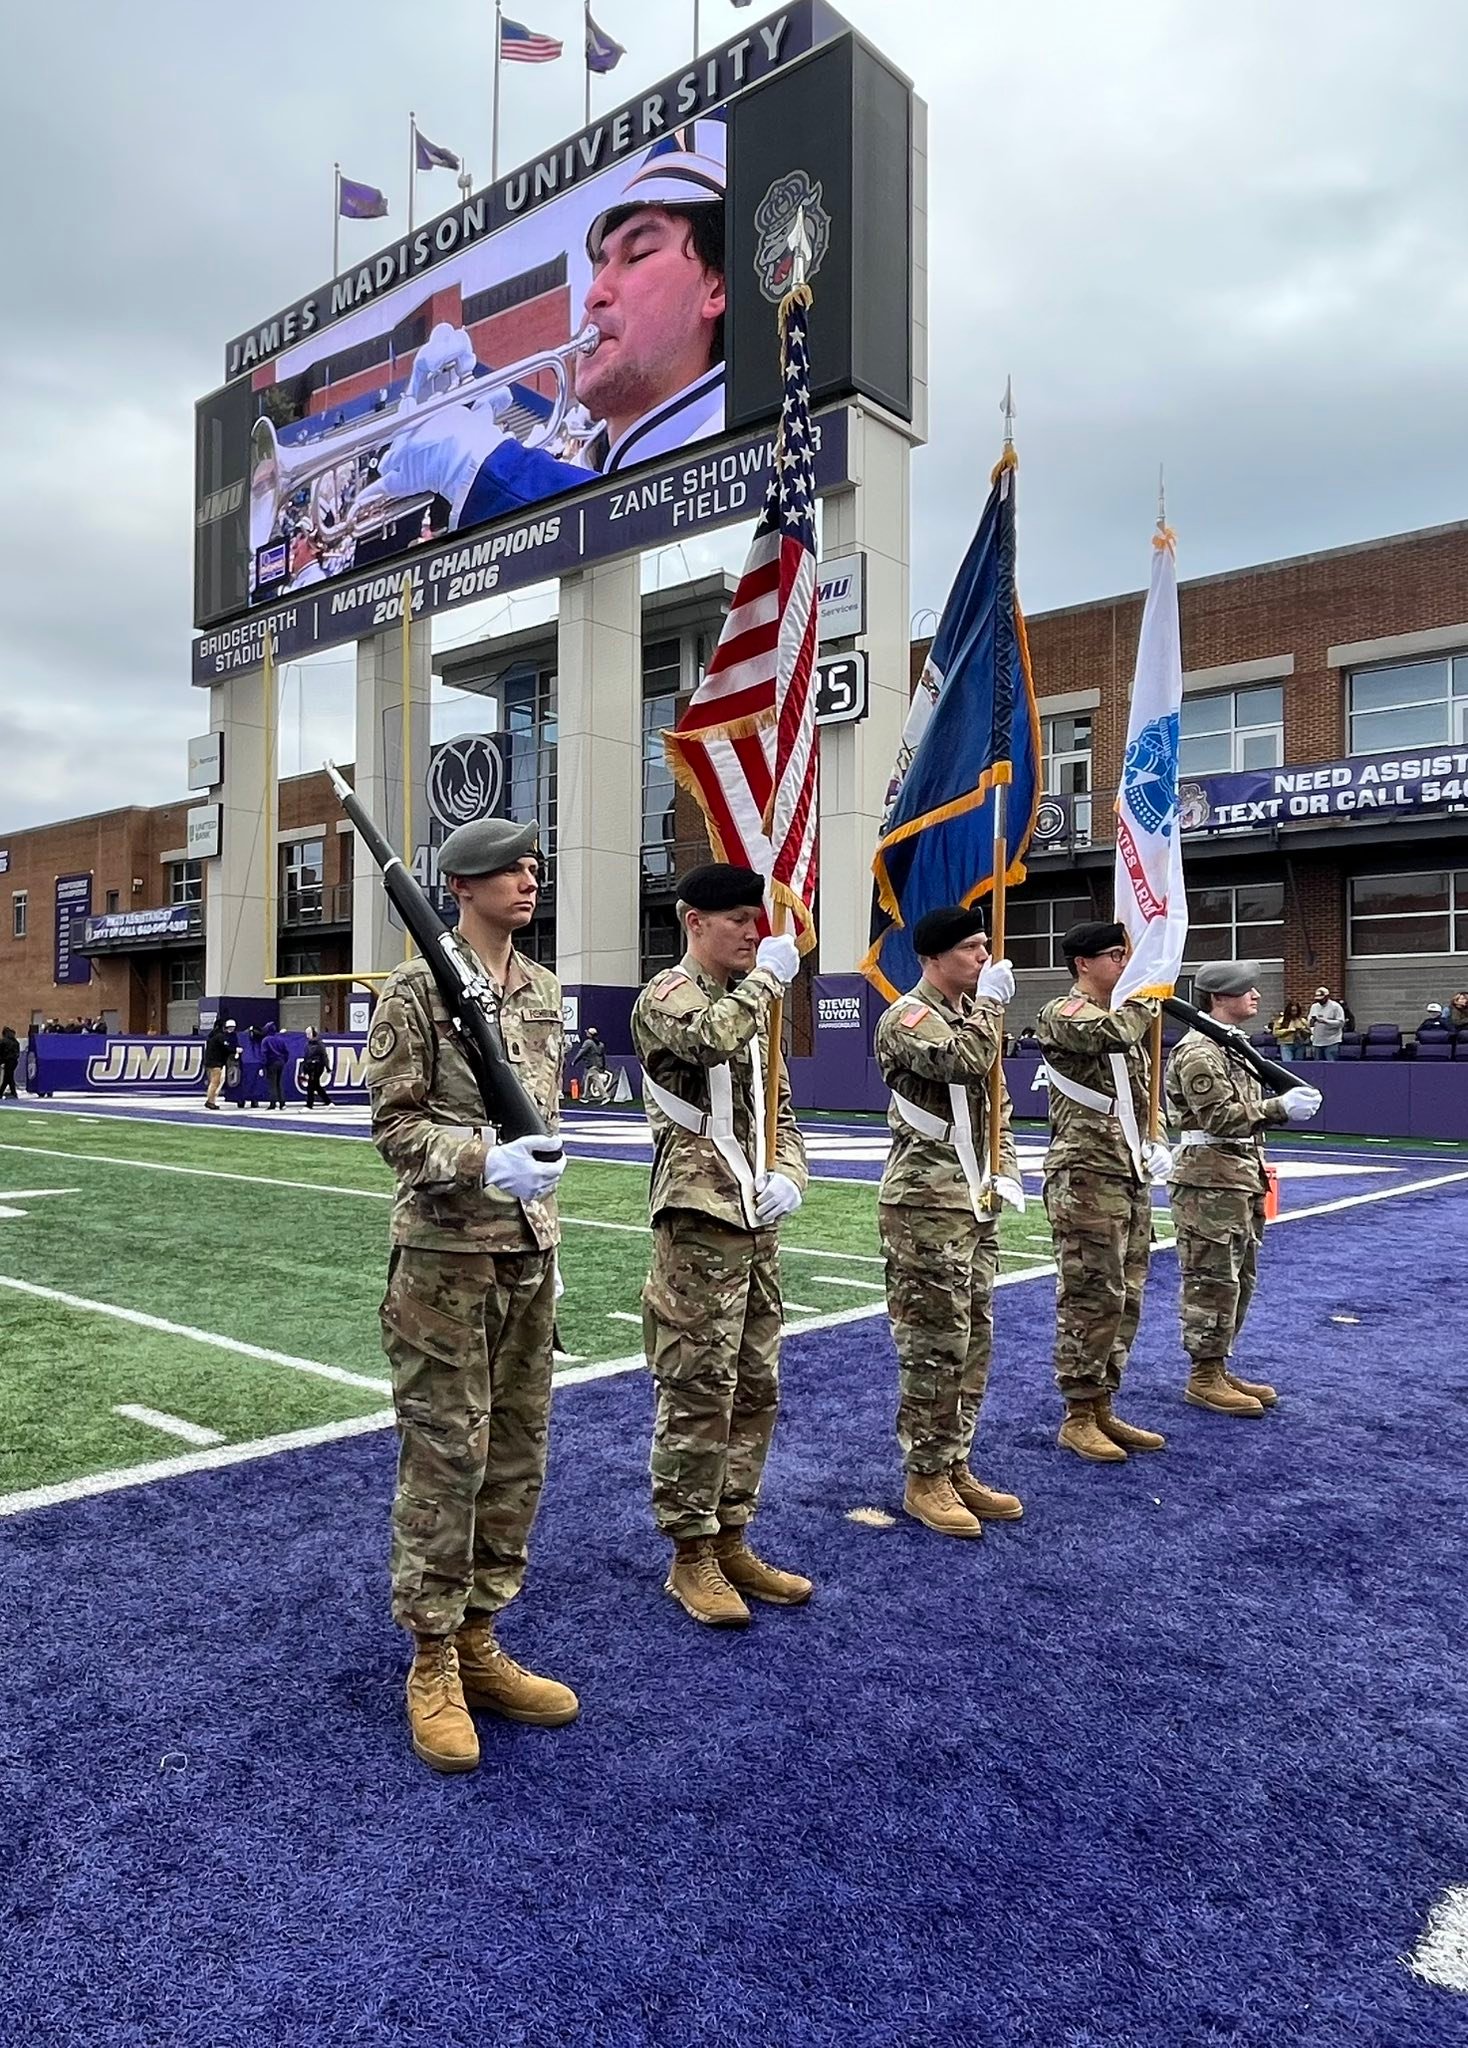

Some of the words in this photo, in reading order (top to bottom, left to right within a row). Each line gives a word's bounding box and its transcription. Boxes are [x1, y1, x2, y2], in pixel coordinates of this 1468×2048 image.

[229, 300, 318, 373] JAMES
[330, 198, 487, 315] MADISON
[505, 14, 789, 212] UNIVERSITY
[608, 476, 675, 521] ZANE
[682, 425, 823, 496] SHOWKR
[672, 482, 747, 527] FIELD
[331, 565, 424, 615] NATIONAL
[428, 516, 562, 582] CHAMPIONS
[447, 564, 500, 602] 2016
[817, 577, 850, 602] MU
[820, 602, 859, 619] Services
[199, 608, 298, 659] BRIDGEFORTH
[1274, 767, 1353, 794] NEED
[1214, 798, 1284, 825] TEXT
[1289, 794, 1330, 816] OR
[1336, 786, 1414, 811] CALL
[1117, 825, 1138, 869] ATES
[1132, 878, 1159, 918] ARM
[818, 997, 860, 1010] STEVEN
[818, 1009, 860, 1020] TOYOTA
[91, 1045, 203, 1081] JMU
